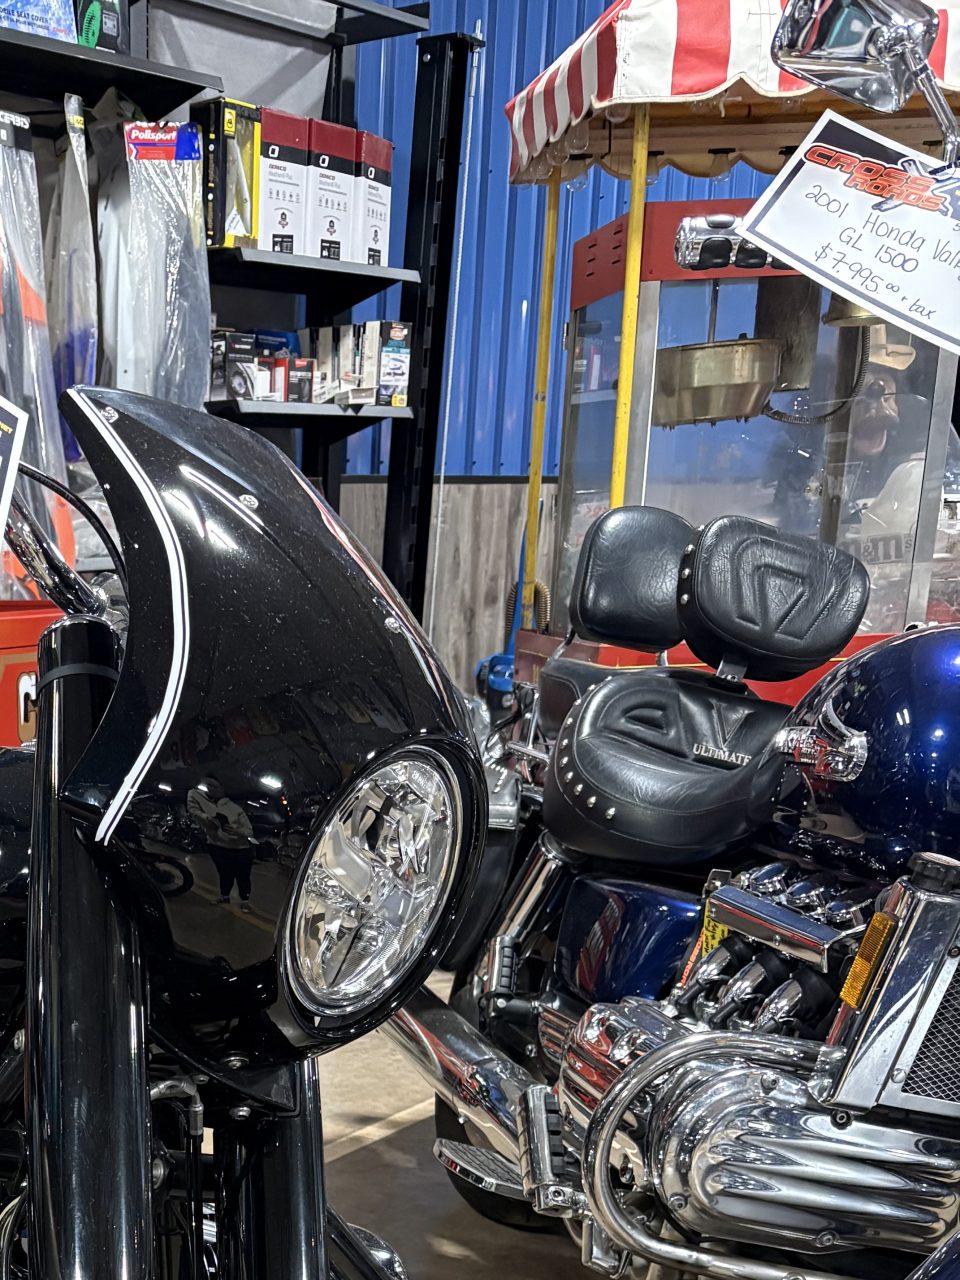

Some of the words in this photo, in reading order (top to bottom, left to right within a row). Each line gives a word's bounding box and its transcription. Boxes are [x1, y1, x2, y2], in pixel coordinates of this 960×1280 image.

[130, 129, 178, 142] Polisport
[804, 145, 937, 193] CROSS
[845, 175, 945, 212] ROADS
[805, 184, 850, 219] 2001
[862, 211, 927, 253] Honda
[839, 226, 863, 252] GL
[874, 243, 920, 274] 1500
[908, 298, 937, 320] tax
[692, 743, 753, 767] ULTIMATE
